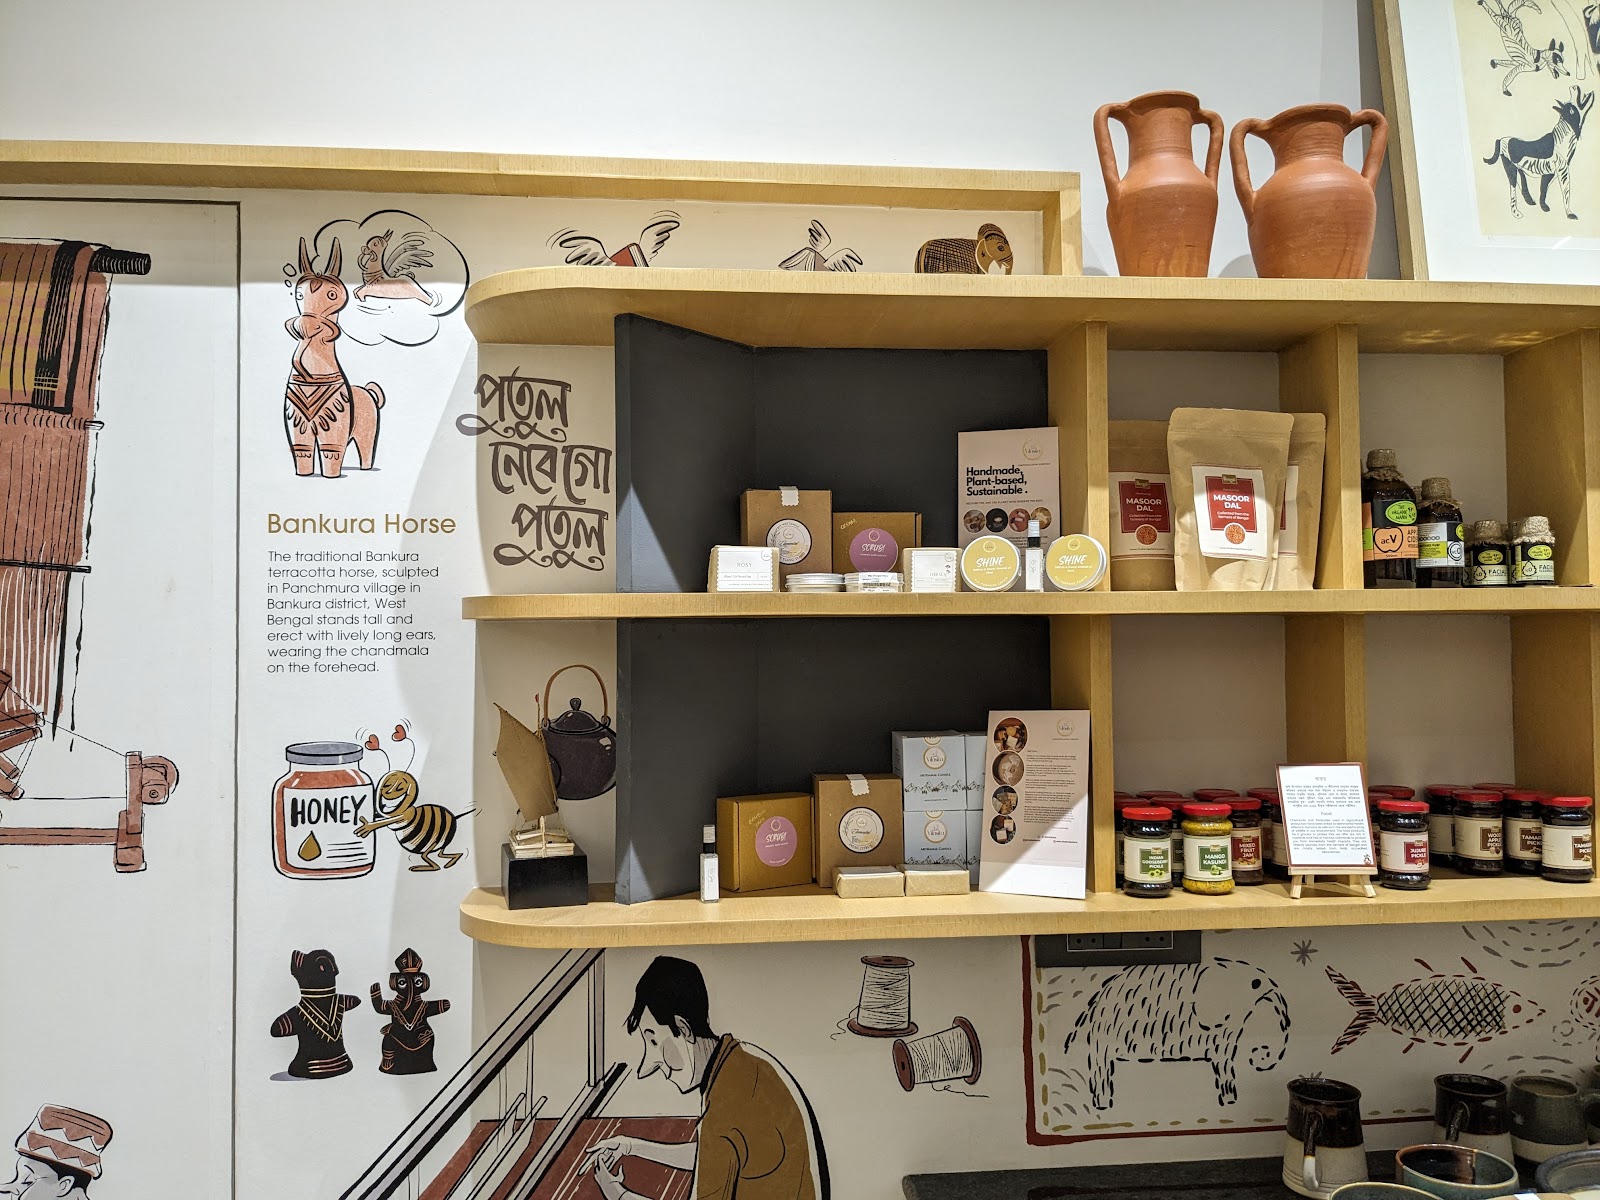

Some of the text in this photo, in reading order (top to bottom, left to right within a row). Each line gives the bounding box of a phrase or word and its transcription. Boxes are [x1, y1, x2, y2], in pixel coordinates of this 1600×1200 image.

[456, 366, 571, 442] পুতুল
[966, 465, 1024, 477] Handmade,
[966, 475, 1028, 486] Plant-based,
[1213, 494, 1250, 502] MASOOR
[268, 514, 456, 533] Bankura Horse
[494, 495, 608, 571] পুতুল
[268, 551, 419, 561] The traditional Bankura
[1059, 555, 1087, 565] SHINE
[976, 557, 1005, 568] SHINE
[268, 567, 438, 579] terracotta horse, sculpted
[268, 582, 420, 596] in Panchmura village in
[268, 598, 407, 609] Bankura district, West
[268, 614, 412, 627] Bengal stands tall and
[267, 630, 436, 643] erect with lively long ears,
[268, 645, 428, 659] wearing the chandmala
[267, 661, 379, 673] on the forehead.
[290, 794, 367, 827] HONEY
